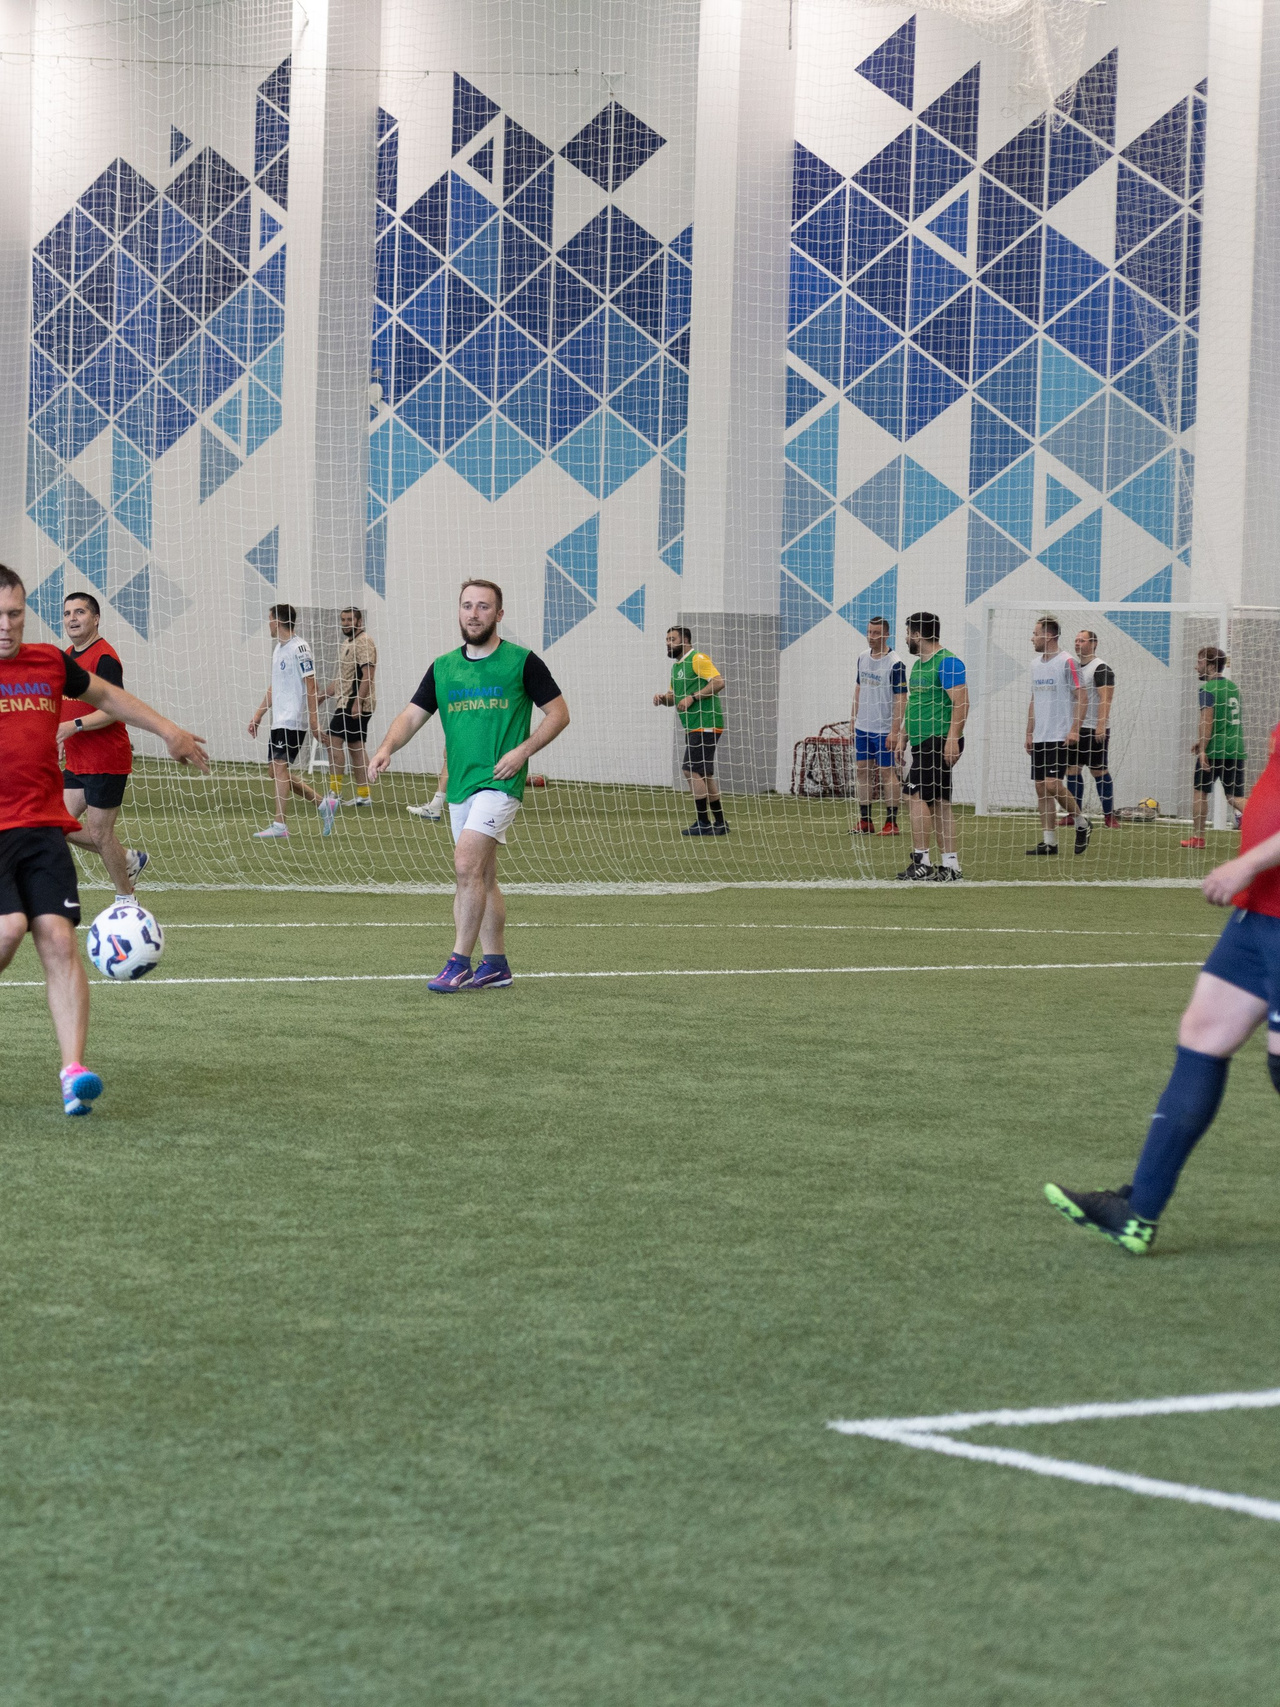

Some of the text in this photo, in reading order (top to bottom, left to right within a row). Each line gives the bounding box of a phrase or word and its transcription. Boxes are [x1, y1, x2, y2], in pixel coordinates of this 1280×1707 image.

[448, 686, 503, 700] DYNAMO
[447, 698, 508, 713] ARENA.RU
[1228, 697, 1240, 725] 2
